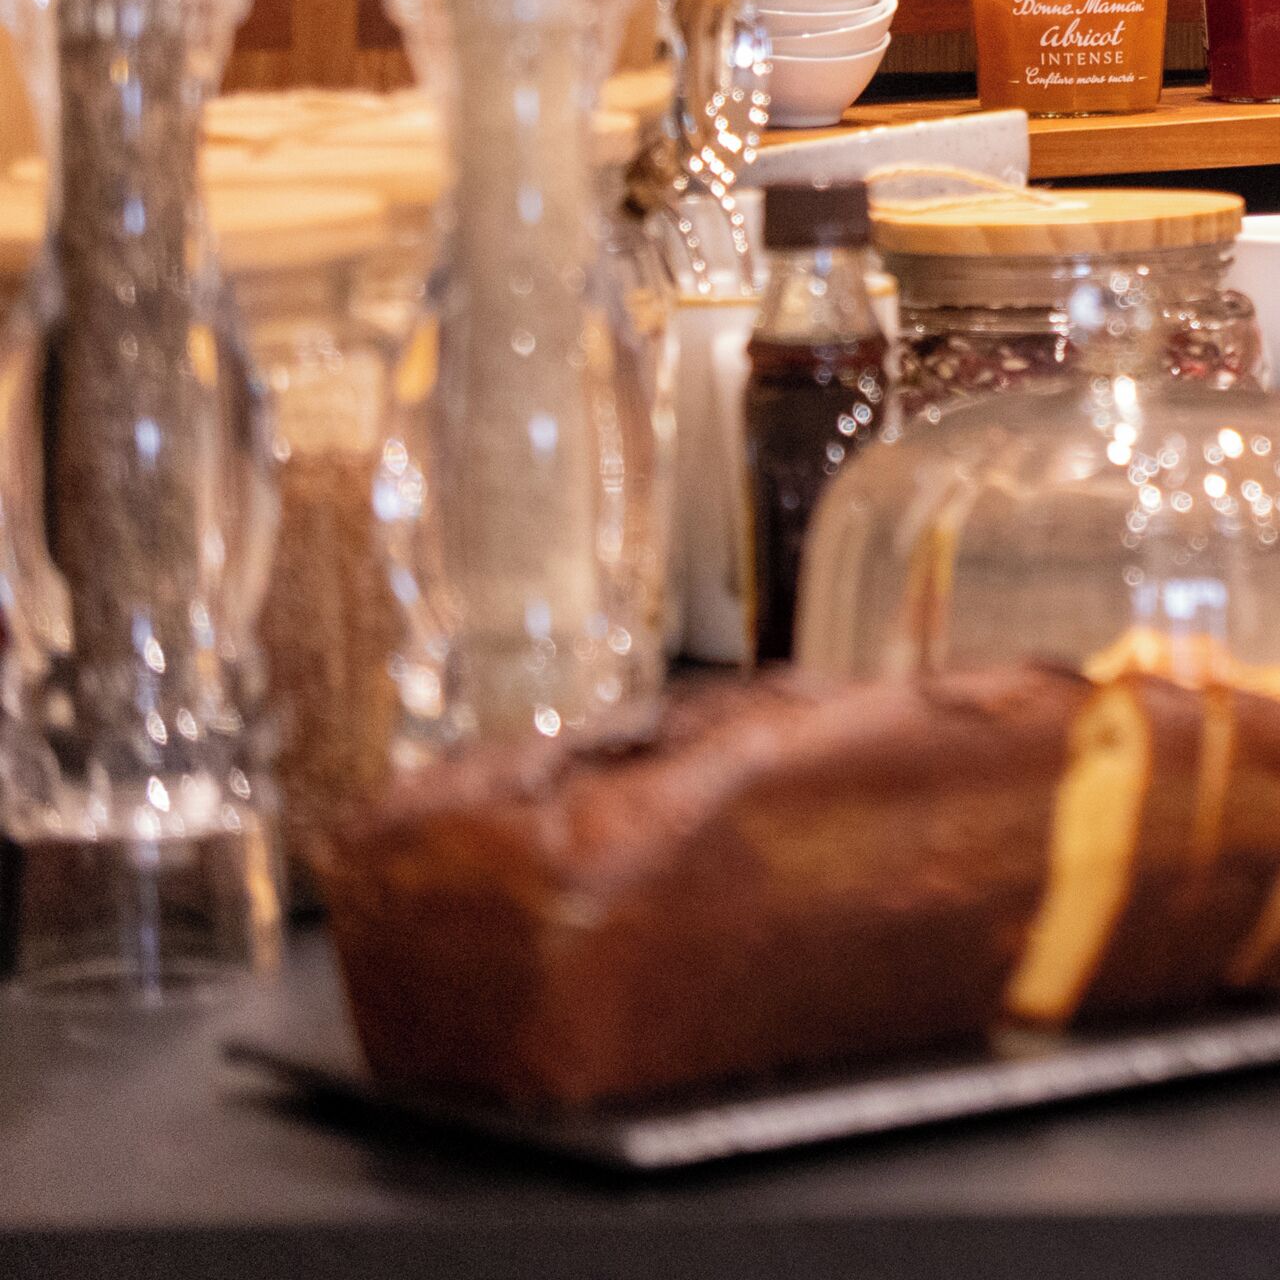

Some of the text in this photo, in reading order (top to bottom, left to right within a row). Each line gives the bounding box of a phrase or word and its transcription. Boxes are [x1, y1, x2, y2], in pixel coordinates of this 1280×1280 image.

[1041, 51, 1124, 66] INTENSE
[1025, 67, 1074, 89] Confiture
[1076, 74, 1106, 85] moins
